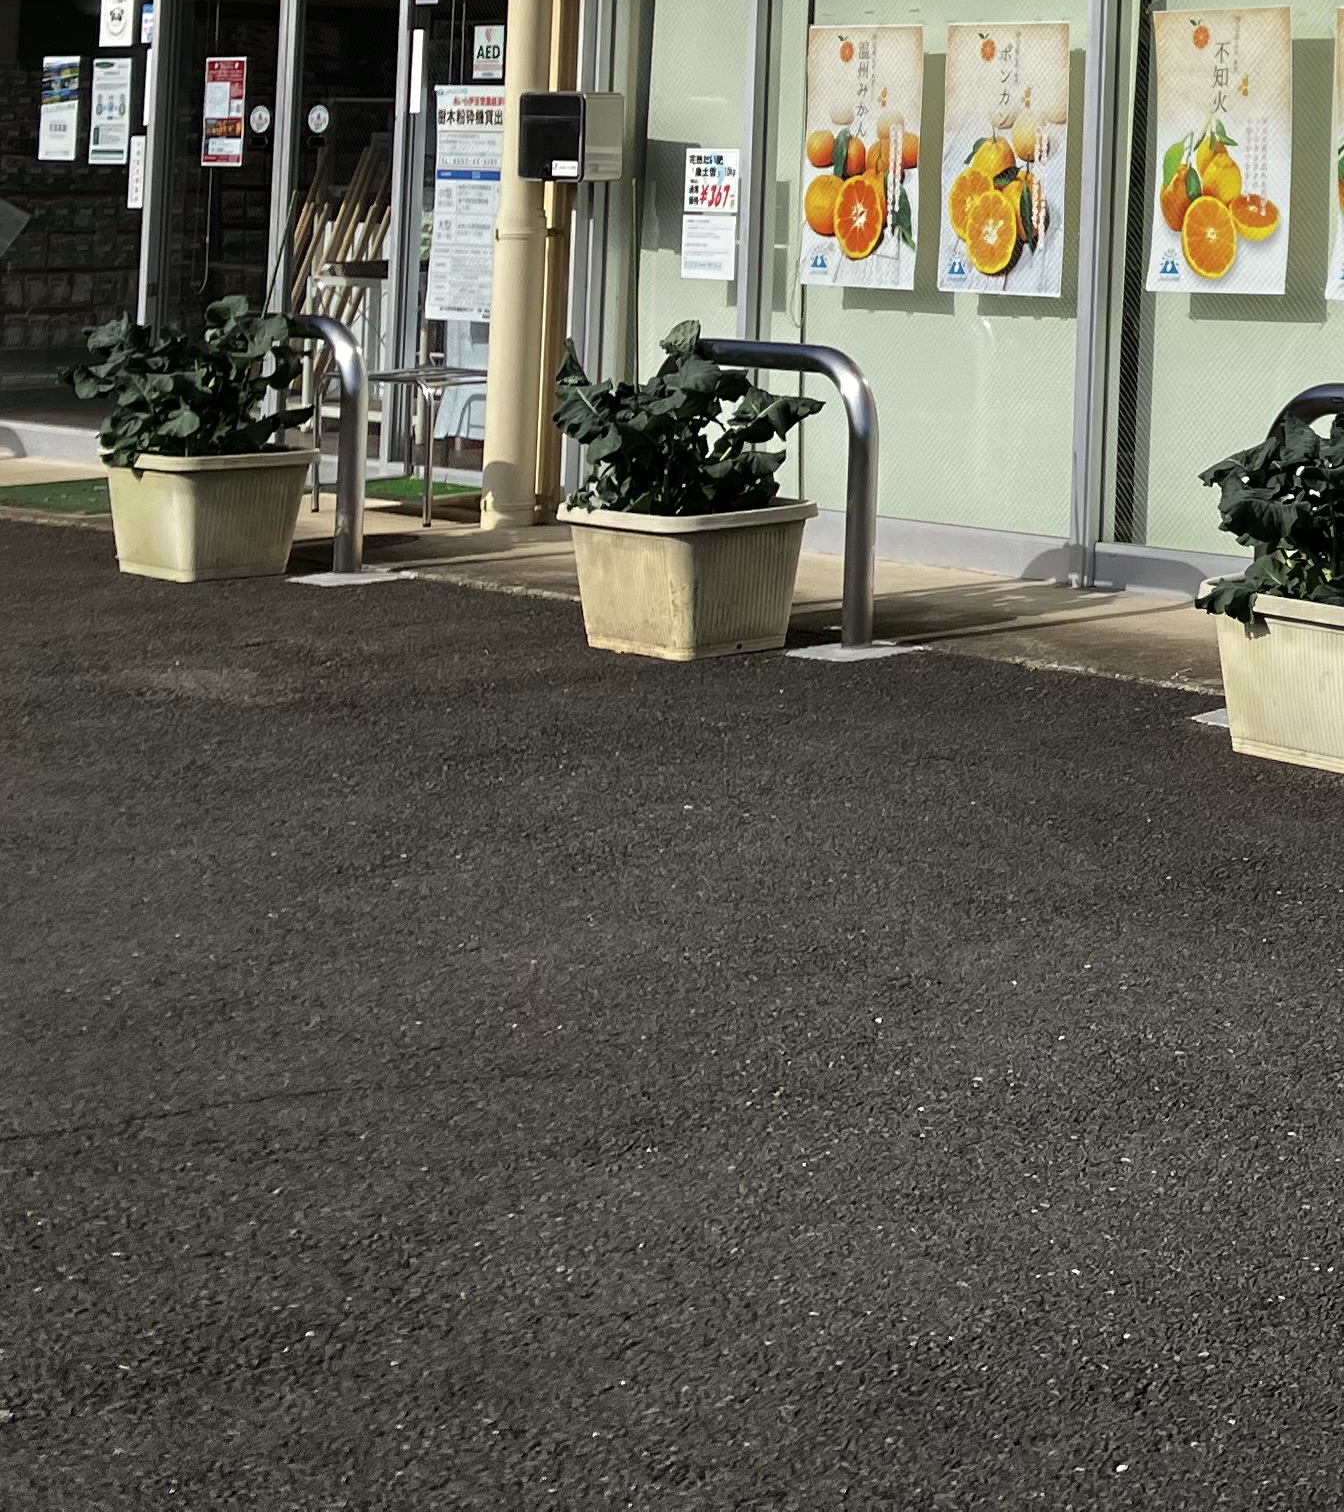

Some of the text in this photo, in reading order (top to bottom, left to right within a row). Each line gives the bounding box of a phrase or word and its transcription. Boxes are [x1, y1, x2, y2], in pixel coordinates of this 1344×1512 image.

[476, 45, 500, 59] AED
[1212, 41, 1230, 113] 不知火
